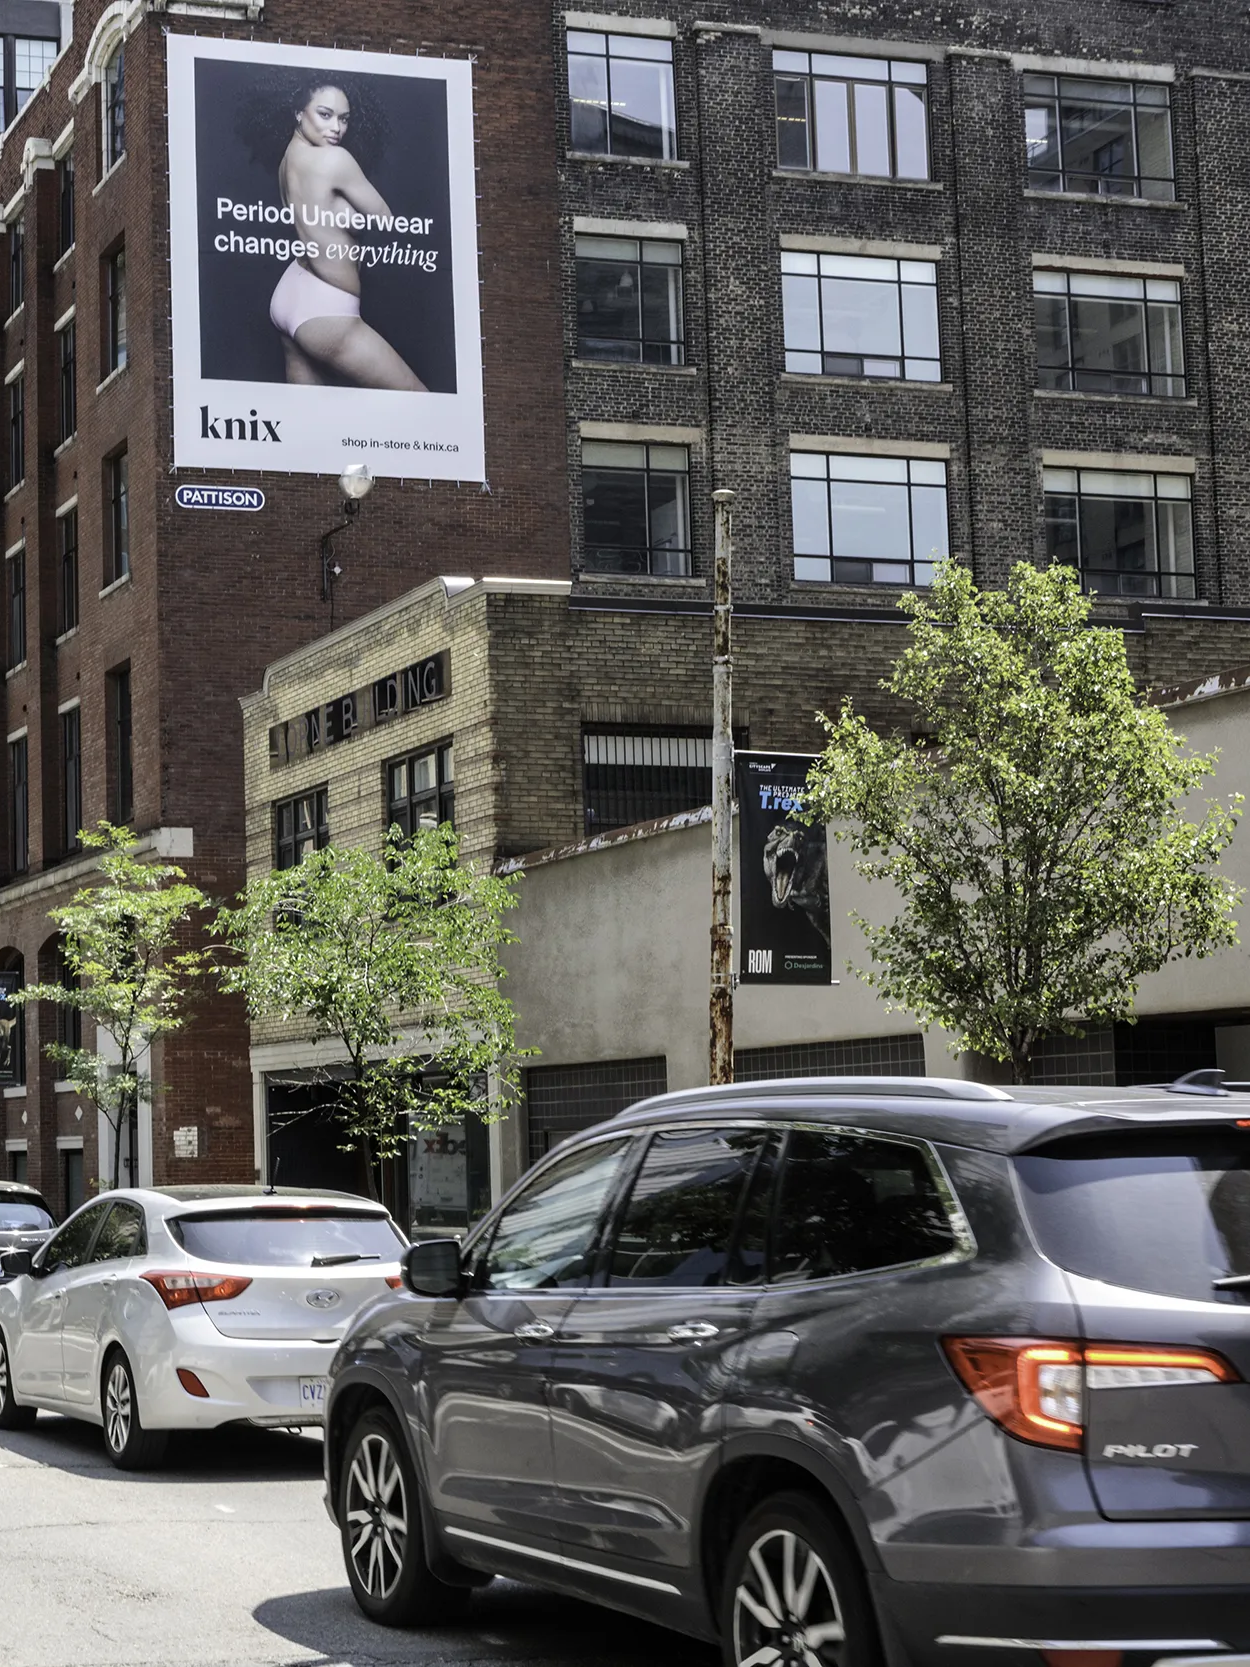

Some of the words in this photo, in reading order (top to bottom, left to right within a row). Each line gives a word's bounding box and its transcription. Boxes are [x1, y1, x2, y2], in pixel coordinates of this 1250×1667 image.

[217, 197, 295, 225] Period
[302, 204, 434, 235] Underwear
[214, 231, 320, 261] changes
[325, 241, 439, 273] everything
[200, 405, 282, 443] knix
[341, 437, 368, 449] shop
[370, 438, 411, 450] in-store
[412, 440, 421, 451] &
[423, 441, 459, 453] knix.ca
[183, 489, 258, 507] PATTISON
[342, 661, 437, 736] BUILDING
[759, 790, 803, 811] T.rex
[773, 785, 805, 793] ULTIMATE
[748, 949, 773, 974] ROM
[1102, 1444, 1200, 1458] PILOT
